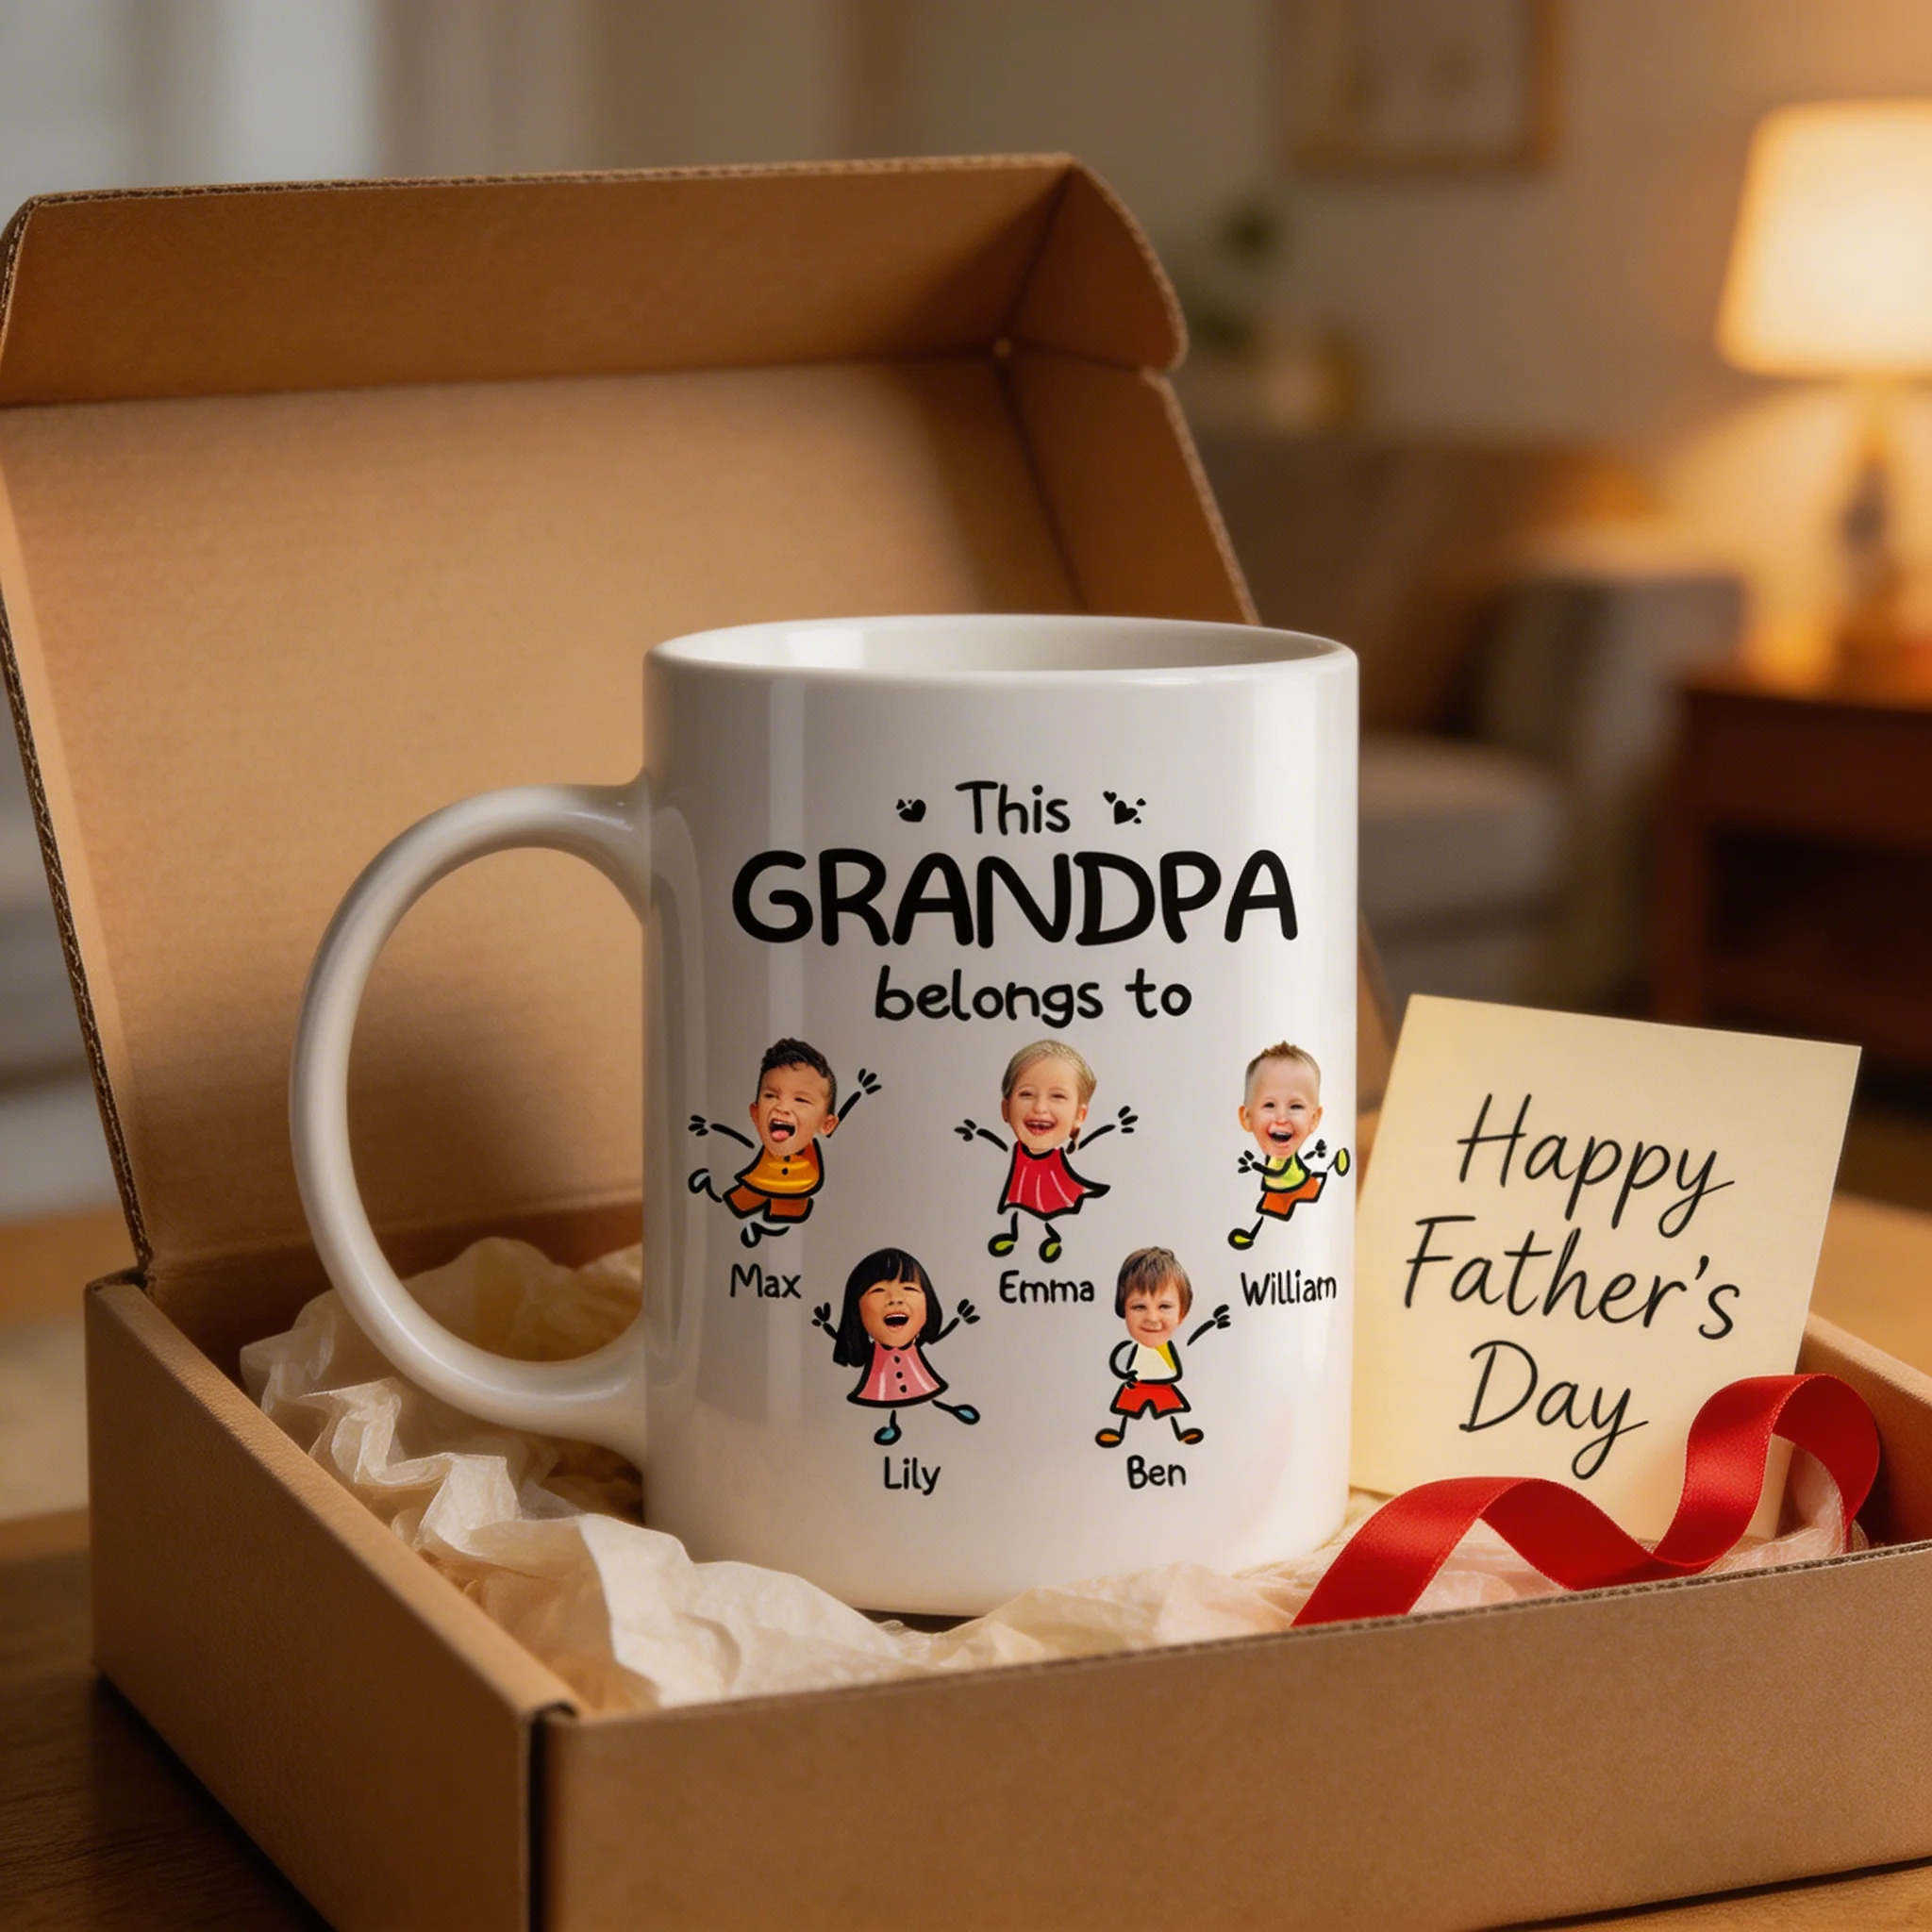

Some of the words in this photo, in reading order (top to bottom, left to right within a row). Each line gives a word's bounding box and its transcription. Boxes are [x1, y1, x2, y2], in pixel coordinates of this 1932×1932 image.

[955, 780, 1071, 837] This
[732, 849, 1298, 949] GRANDPA
[874, 964, 1104, 1029] belongs
[1124, 968, 1192, 1019] to
[1457, 1093, 1735, 1239] Happy
[729, 1263, 803, 1299] Max
[999, 1270, 1095, 1305] Emma
[1241, 1270, 1337, 1307] William
[1404, 1214, 1740, 1341] Father's
[1458, 1340, 1649, 1481] Day
[884, 1457, 941, 1496] Lily
[1127, 1455, 1187, 1490] Ben
